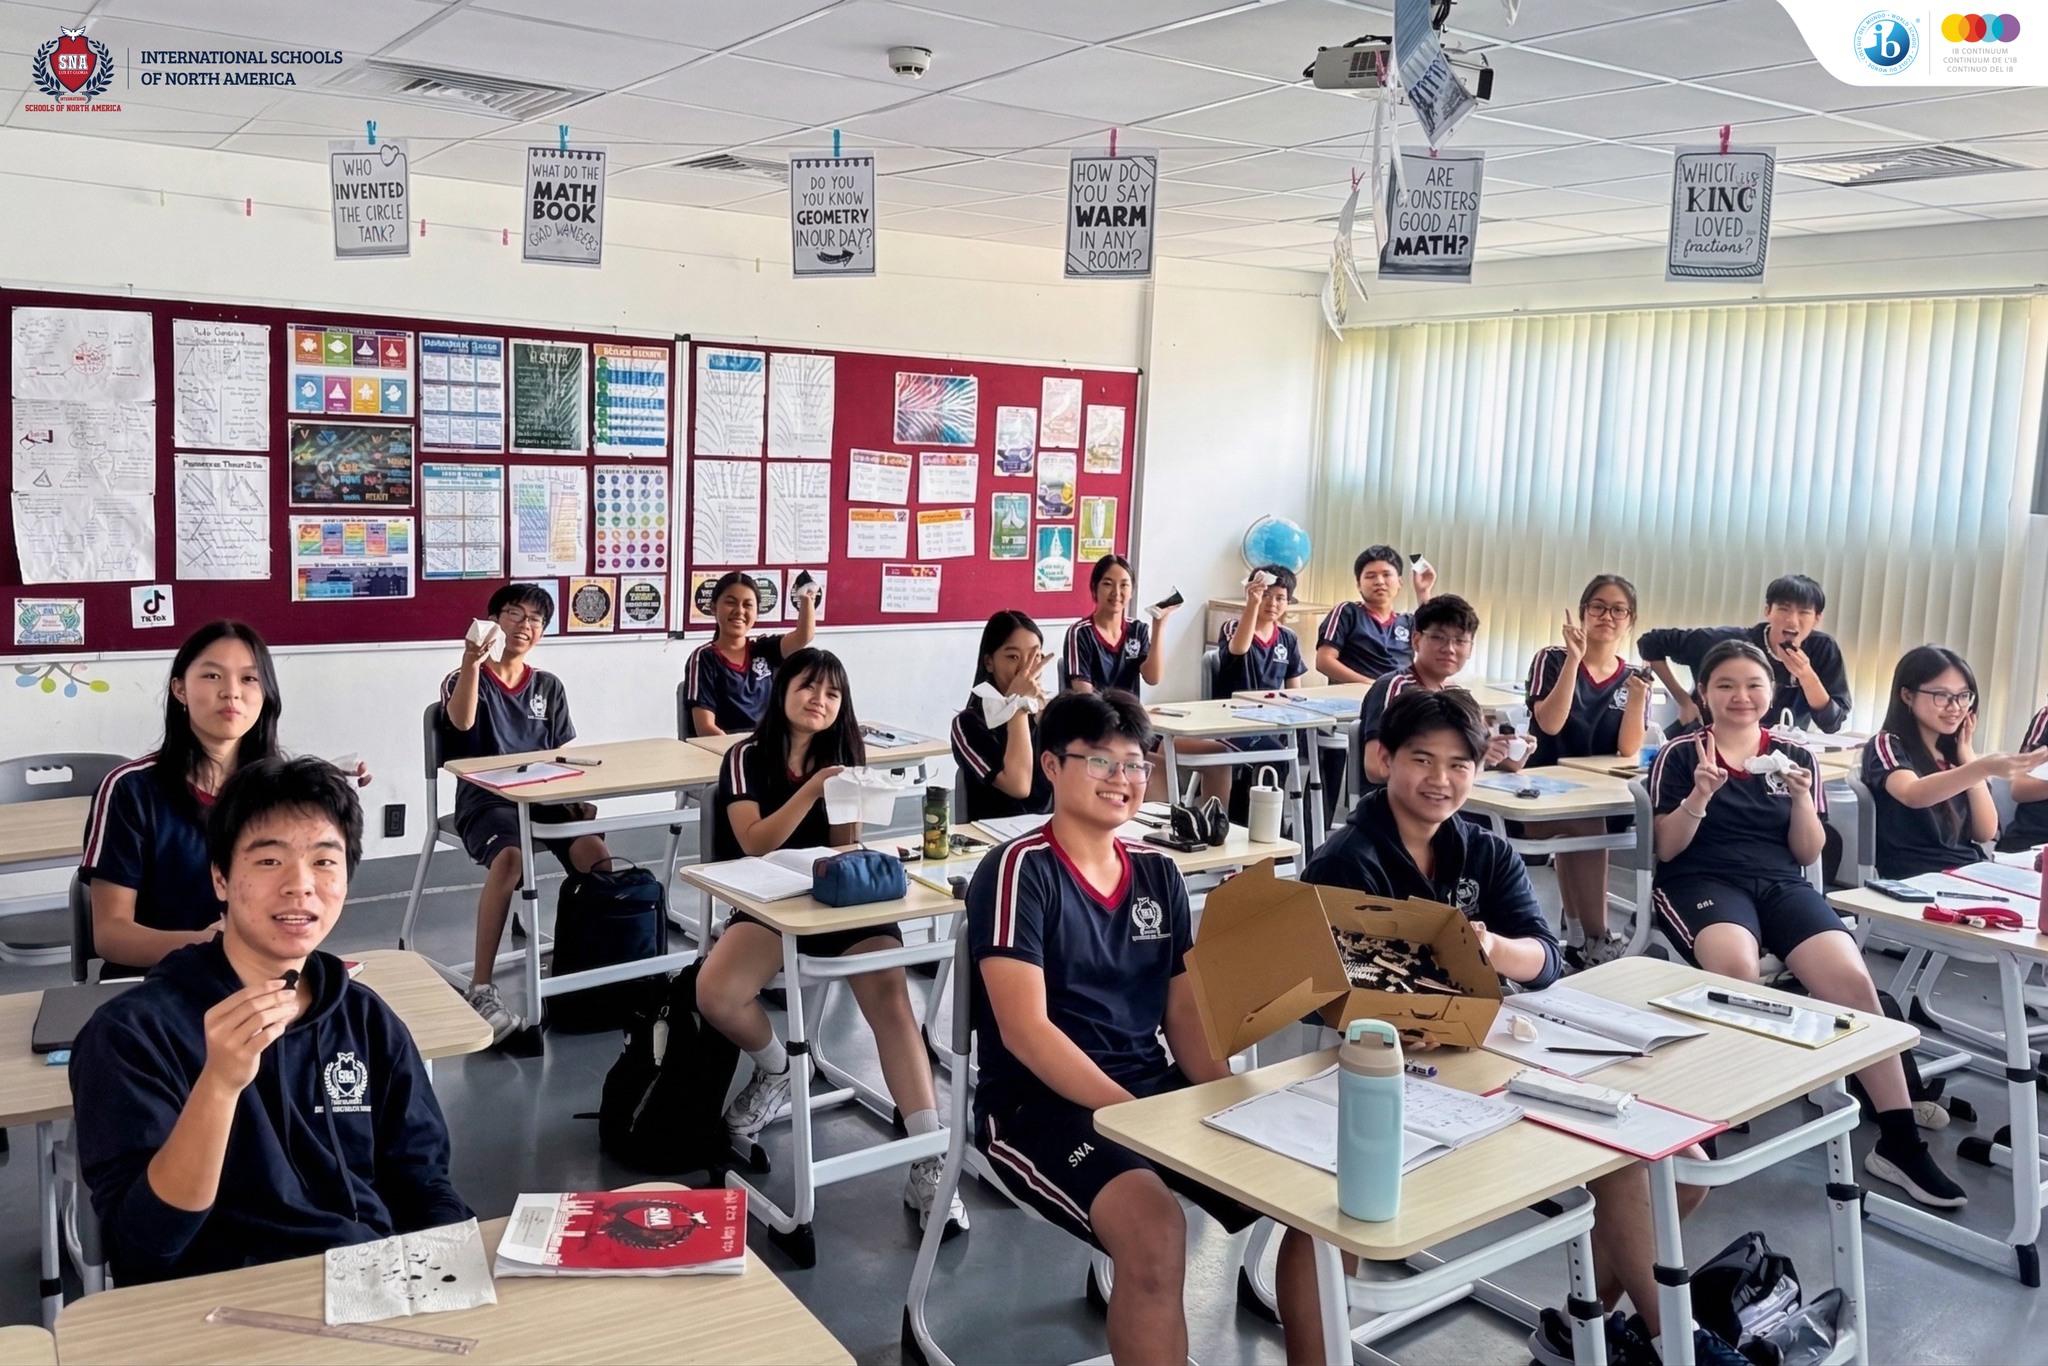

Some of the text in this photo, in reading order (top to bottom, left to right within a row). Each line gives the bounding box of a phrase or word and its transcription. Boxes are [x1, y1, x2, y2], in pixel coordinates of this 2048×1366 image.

[342, 159, 372, 176] WHO
[532, 164, 599, 180] WHAT DO THE
[1077, 163, 1141, 182] HOW DO
[1425, 166, 1455, 187] ARE
[335, 182, 404, 200] INVENTED
[810, 175, 855, 190] DO YOU
[533, 181, 597, 204] MATH
[802, 191, 864, 206] YOU KNOW
[1073, 184, 1151, 203] YOU SAY
[339, 204, 403, 223] THE CIRCLE
[533, 200, 596, 224] BOOK
[796, 208, 869, 226] GEOMETRY
[1075, 205, 1147, 228] WARM
[1399, 211, 1468, 233] GOOD AT
[1695, 216, 1743, 237] LOVED
[358, 223, 395, 242] TANK?
[839, 228, 873, 248] DAY?
[1080, 230, 1137, 249] IN ANY
[1393, 234, 1469, 256] MATH?
[1683, 237, 1754, 258] fractions?
[1088, 248, 1142, 269] ROOM?
[1068, 1142, 1095, 1168] SNA
